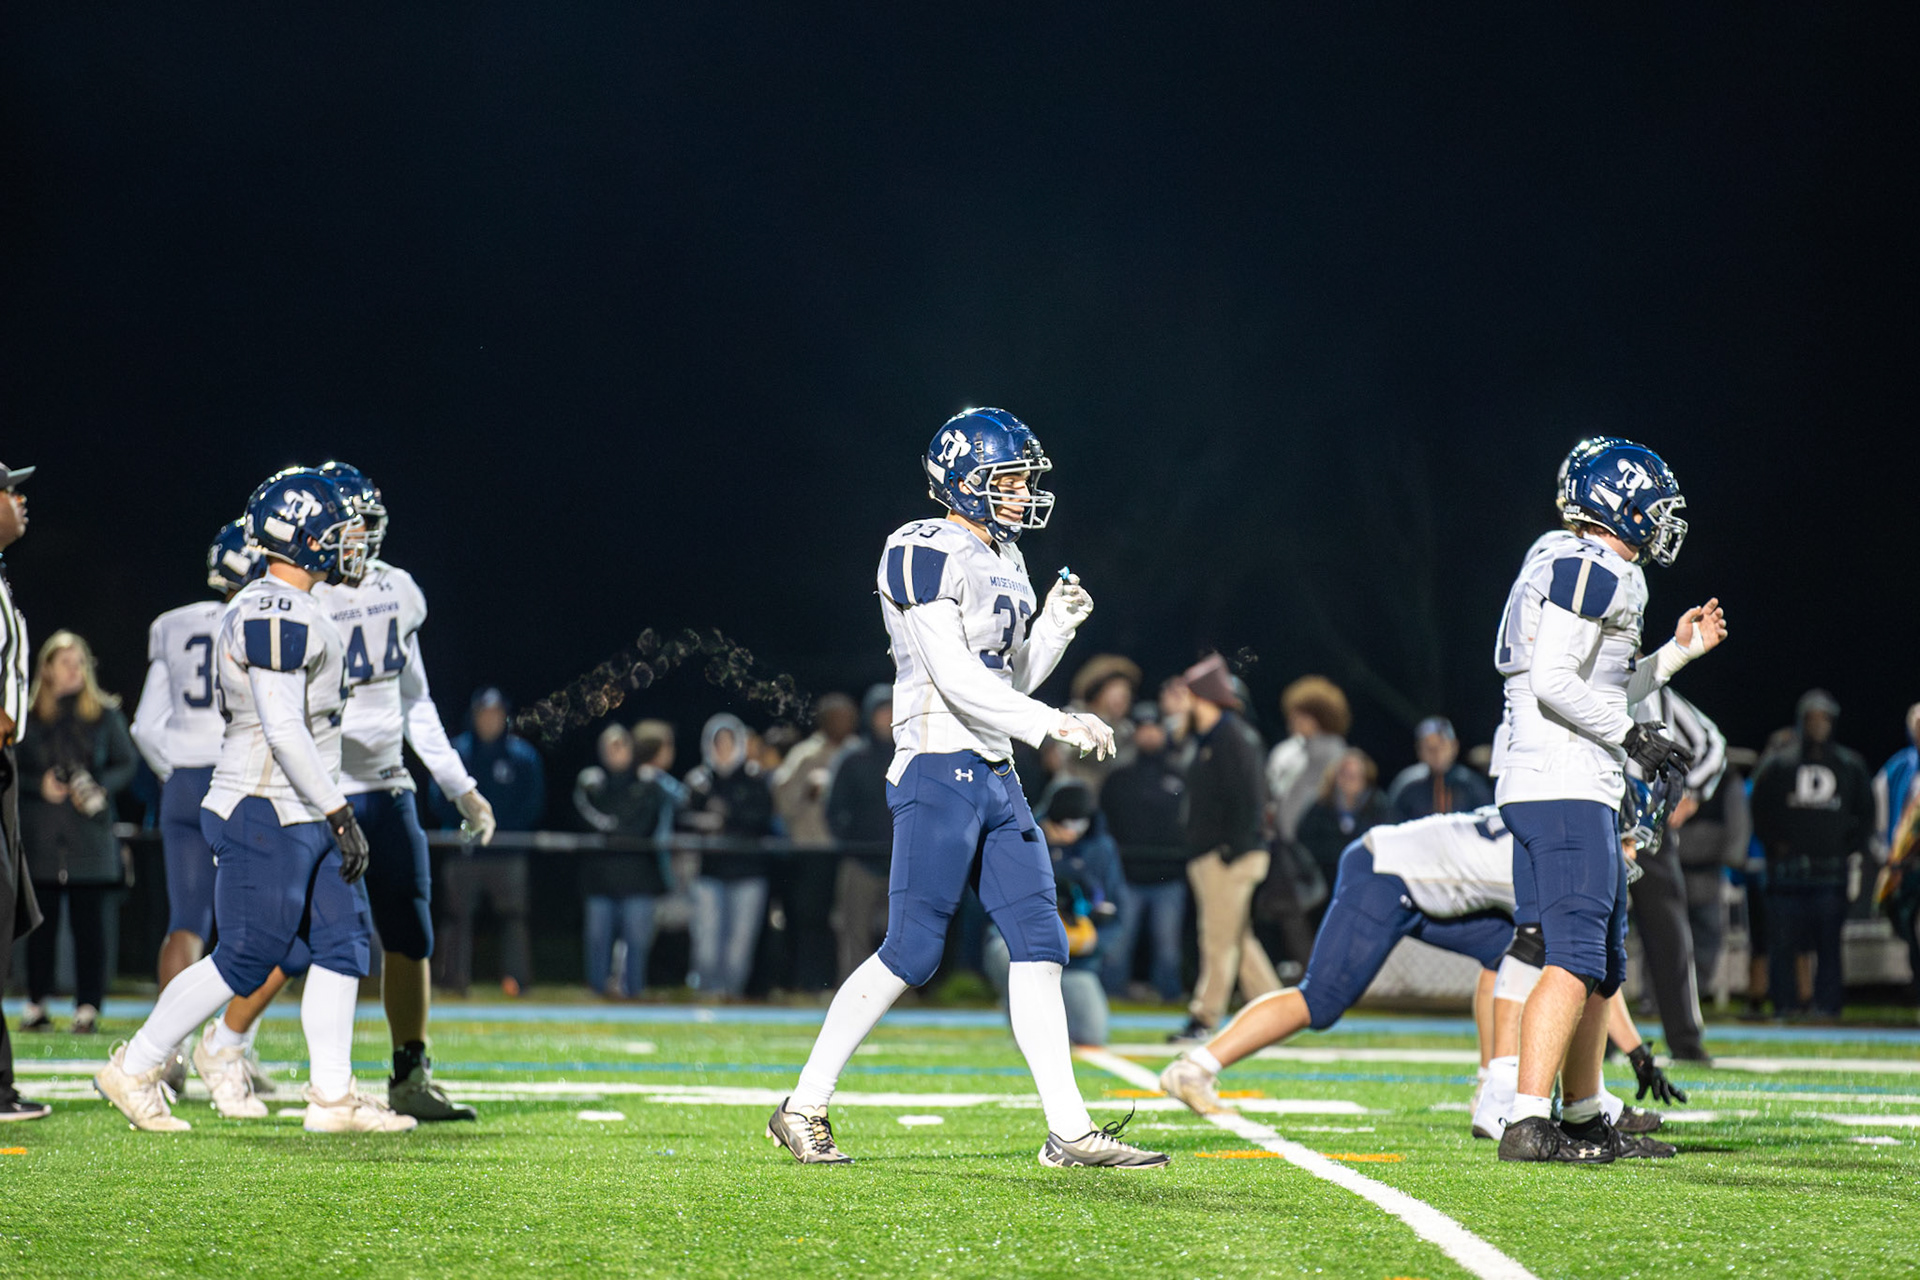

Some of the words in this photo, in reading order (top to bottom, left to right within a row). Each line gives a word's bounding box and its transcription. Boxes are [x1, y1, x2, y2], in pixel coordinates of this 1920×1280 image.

[902, 522, 942, 539] 33
[331, 608, 362, 621] MOSES
[366, 601, 400, 616] BROWN
[346, 616, 407, 678] 44
[1796, 764, 1838, 803] D
